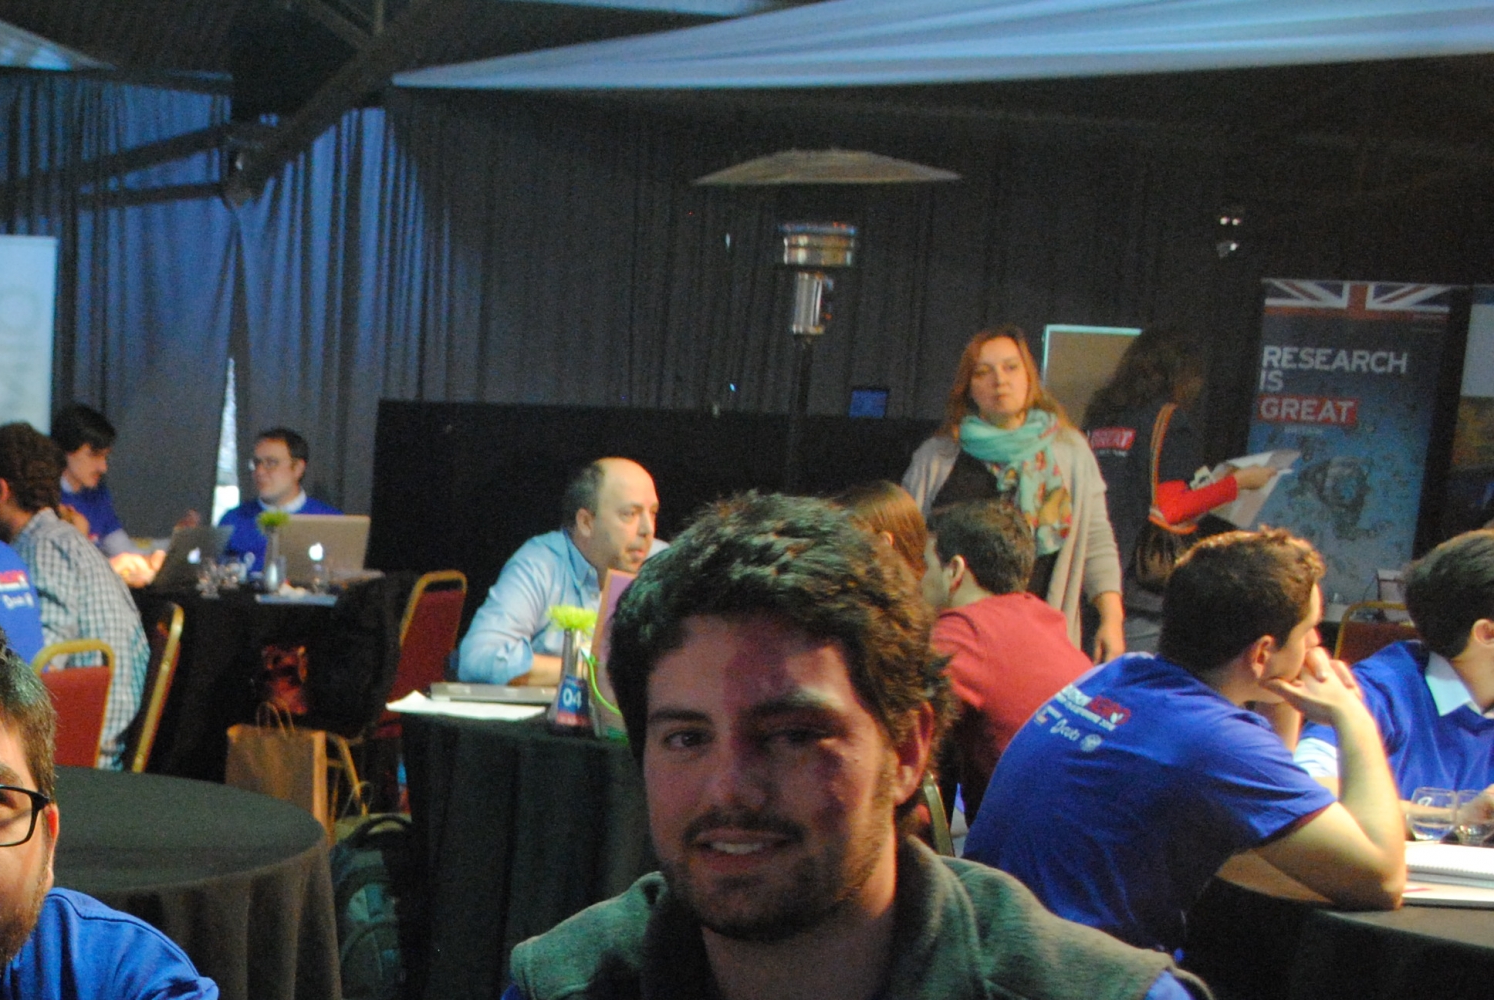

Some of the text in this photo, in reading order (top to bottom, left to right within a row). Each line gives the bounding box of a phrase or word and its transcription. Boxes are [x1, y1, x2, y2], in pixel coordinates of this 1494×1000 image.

[1262, 345, 1408, 374] RESEARCH
[1259, 369, 1283, 391] IS
[1260, 397, 1354, 422] GREAT
